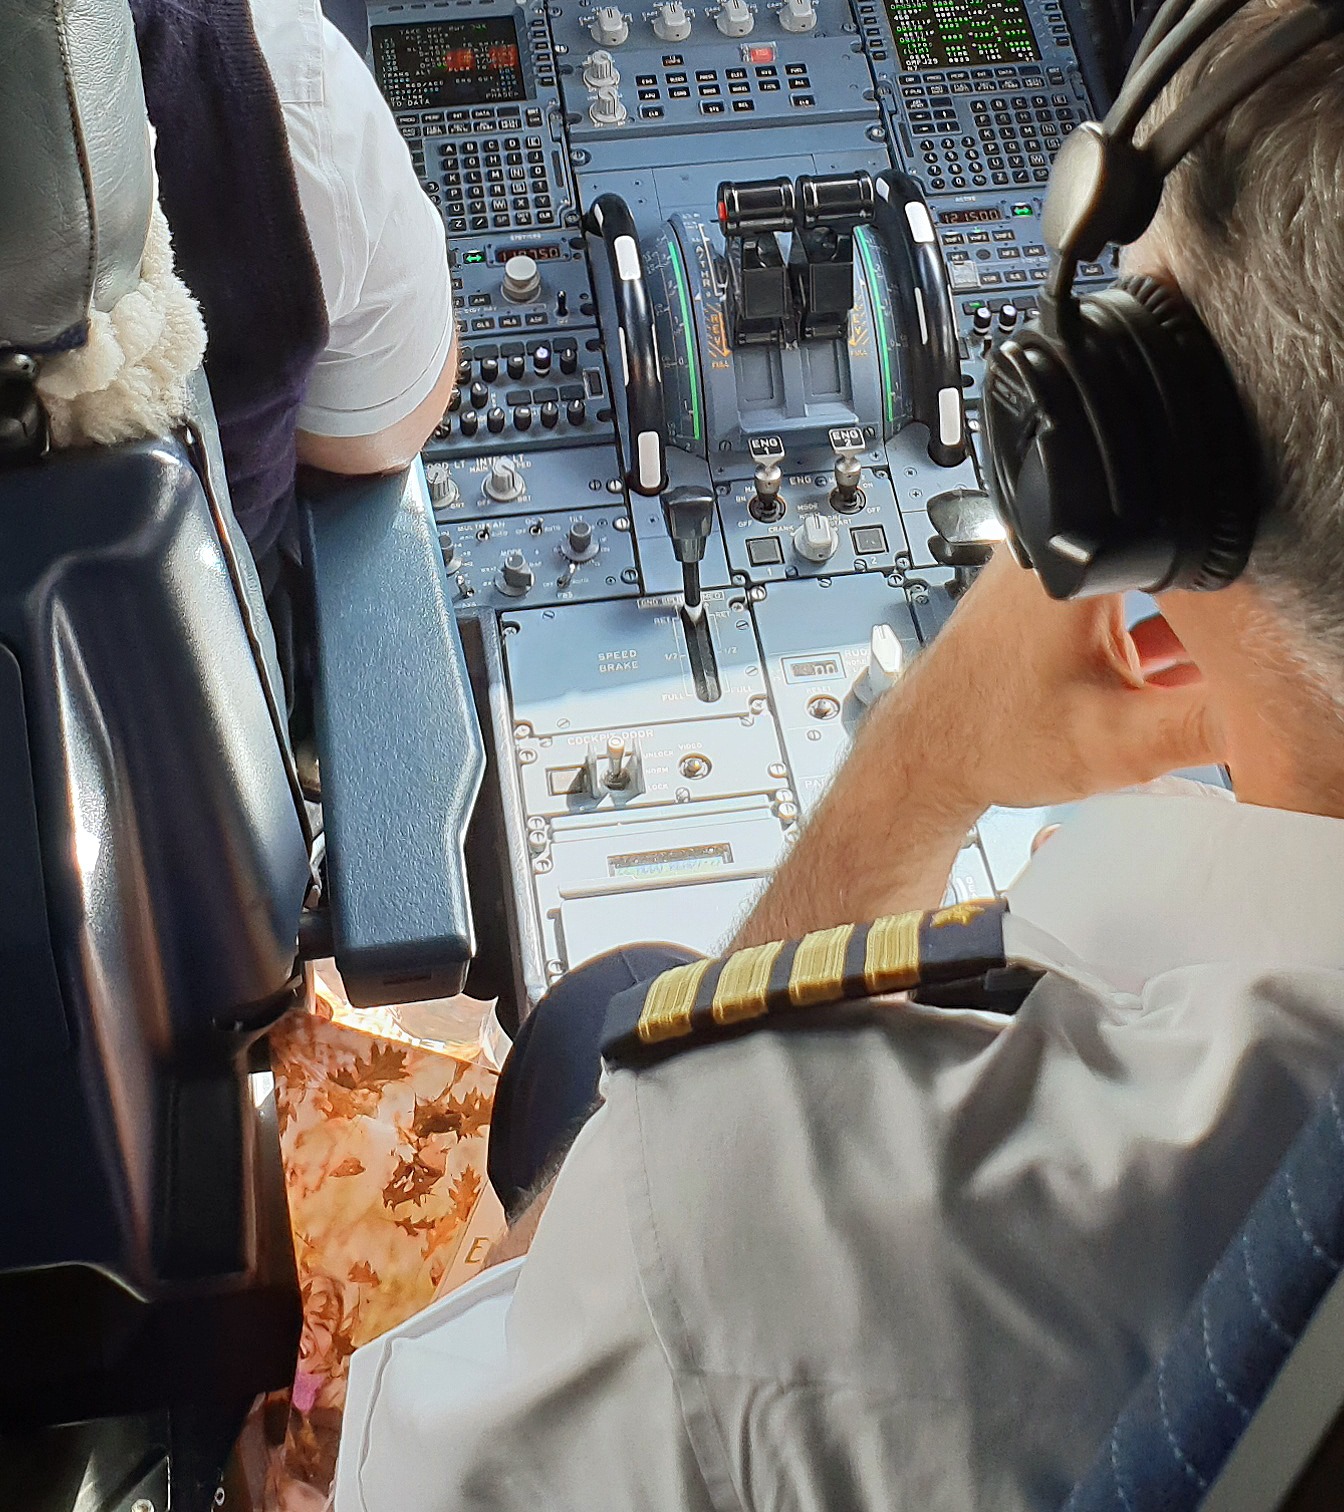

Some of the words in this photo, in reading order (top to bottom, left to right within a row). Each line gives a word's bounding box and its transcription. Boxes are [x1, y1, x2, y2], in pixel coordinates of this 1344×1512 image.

[833, 430, 858, 440] ENG
[752, 438, 778, 449] ENG
[844, 439, 852, 447] 2
[513, 454, 525, 462] LT
[454, 461, 466, 469] LT
[789, 476, 812, 485] ENG
[715, 610, 730, 618] RET
[653, 616, 672, 625] RET
[724, 646, 738, 654] 1/2
[598, 650, 638, 661] SPEED
[664, 653, 678, 661] 1/2
[599, 661, 638, 672] BRAKE
[662, 693, 685, 702] FULL
[567, 732, 621, 746] COCKPIT
[622, 729, 655, 739] DOOR
[678, 742, 703, 751] VIDEO
[643, 749, 674, 759] UNLOCK
[645, 766, 669, 775] NORM
[646, 783, 669, 791] LOCK
